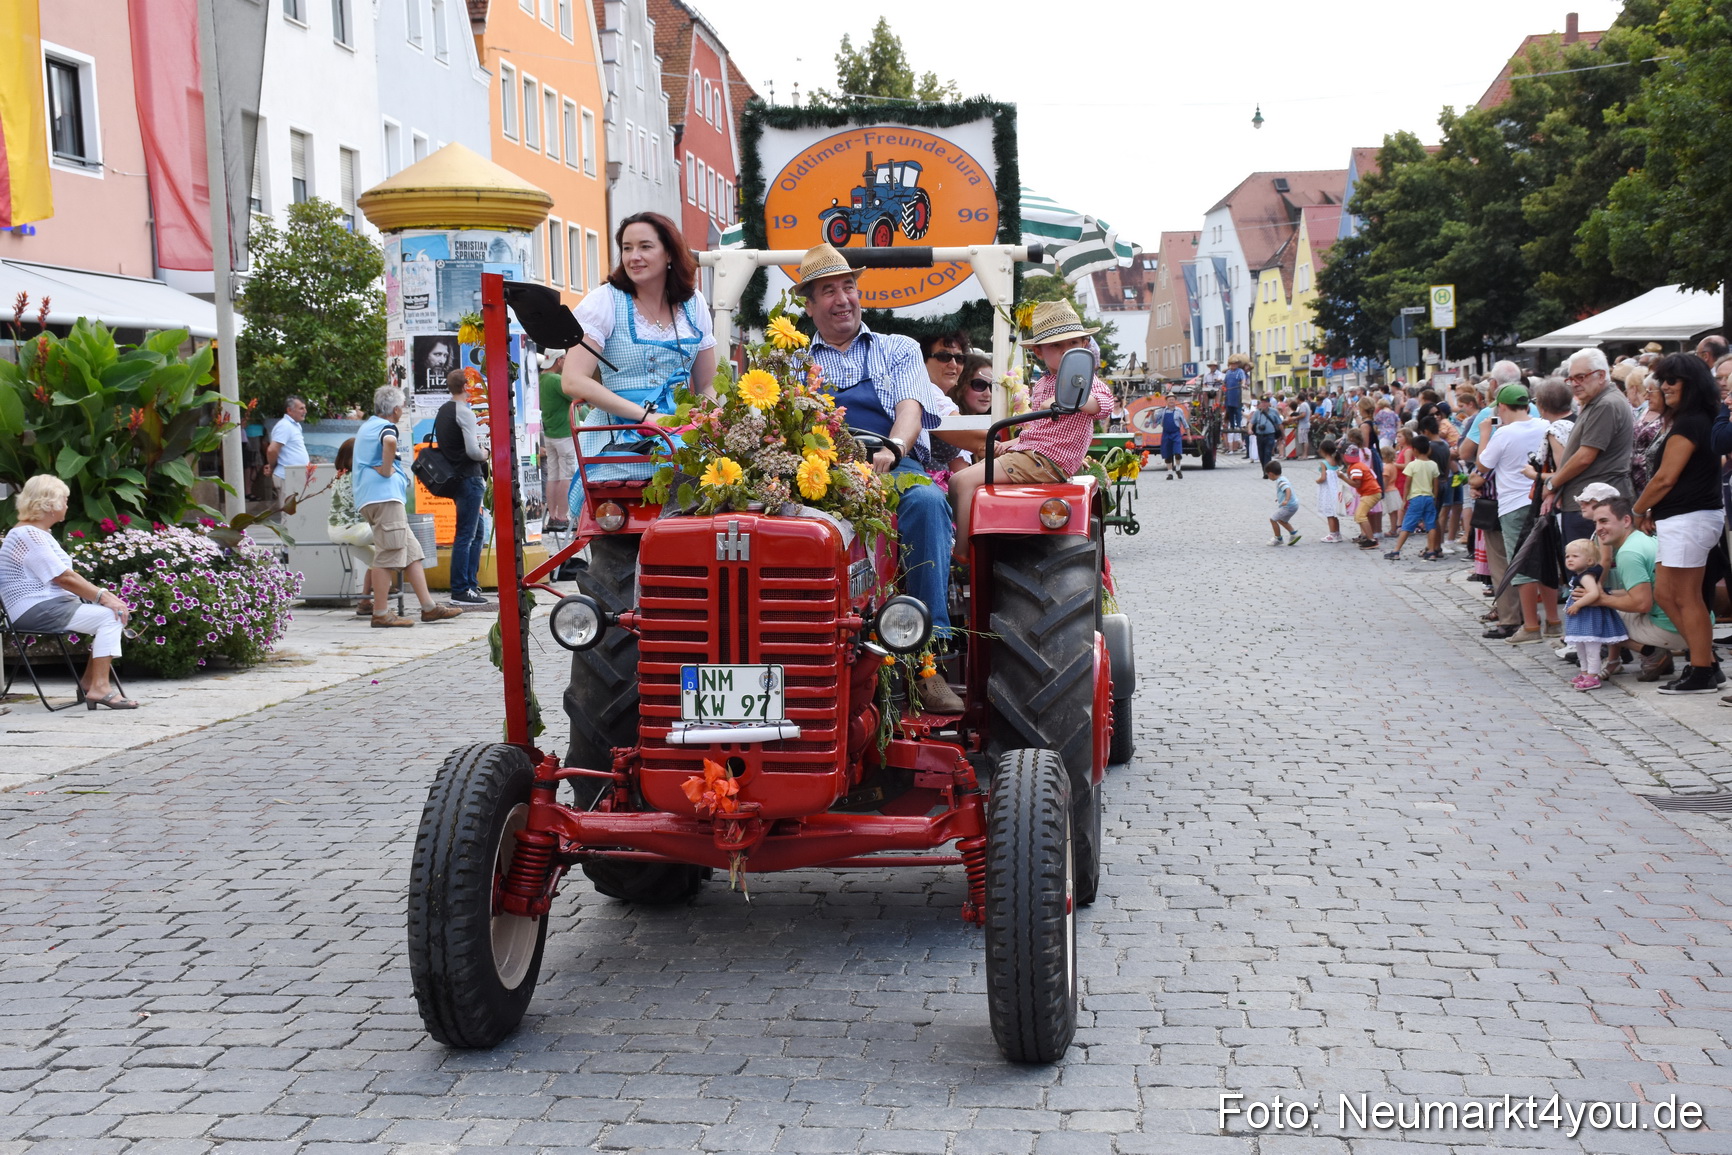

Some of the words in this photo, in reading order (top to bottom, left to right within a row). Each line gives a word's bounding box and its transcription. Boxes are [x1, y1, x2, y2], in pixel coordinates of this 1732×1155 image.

[780, 131, 946, 192] Oldtimer-Freunde
[947, 153, 982, 187] Jura
[772, 214, 798, 230] 19
[957, 207, 990, 223] 96
[454, 240, 488, 251] CHRISTIAN
[454, 251, 486, 260] SPRINGER
[426, 368, 447, 388] fitz
[687, 681, 694, 689] D
[701, 669, 733, 692] NM
[694, 694, 725, 717] KW
[740, 694, 771, 717] 97
